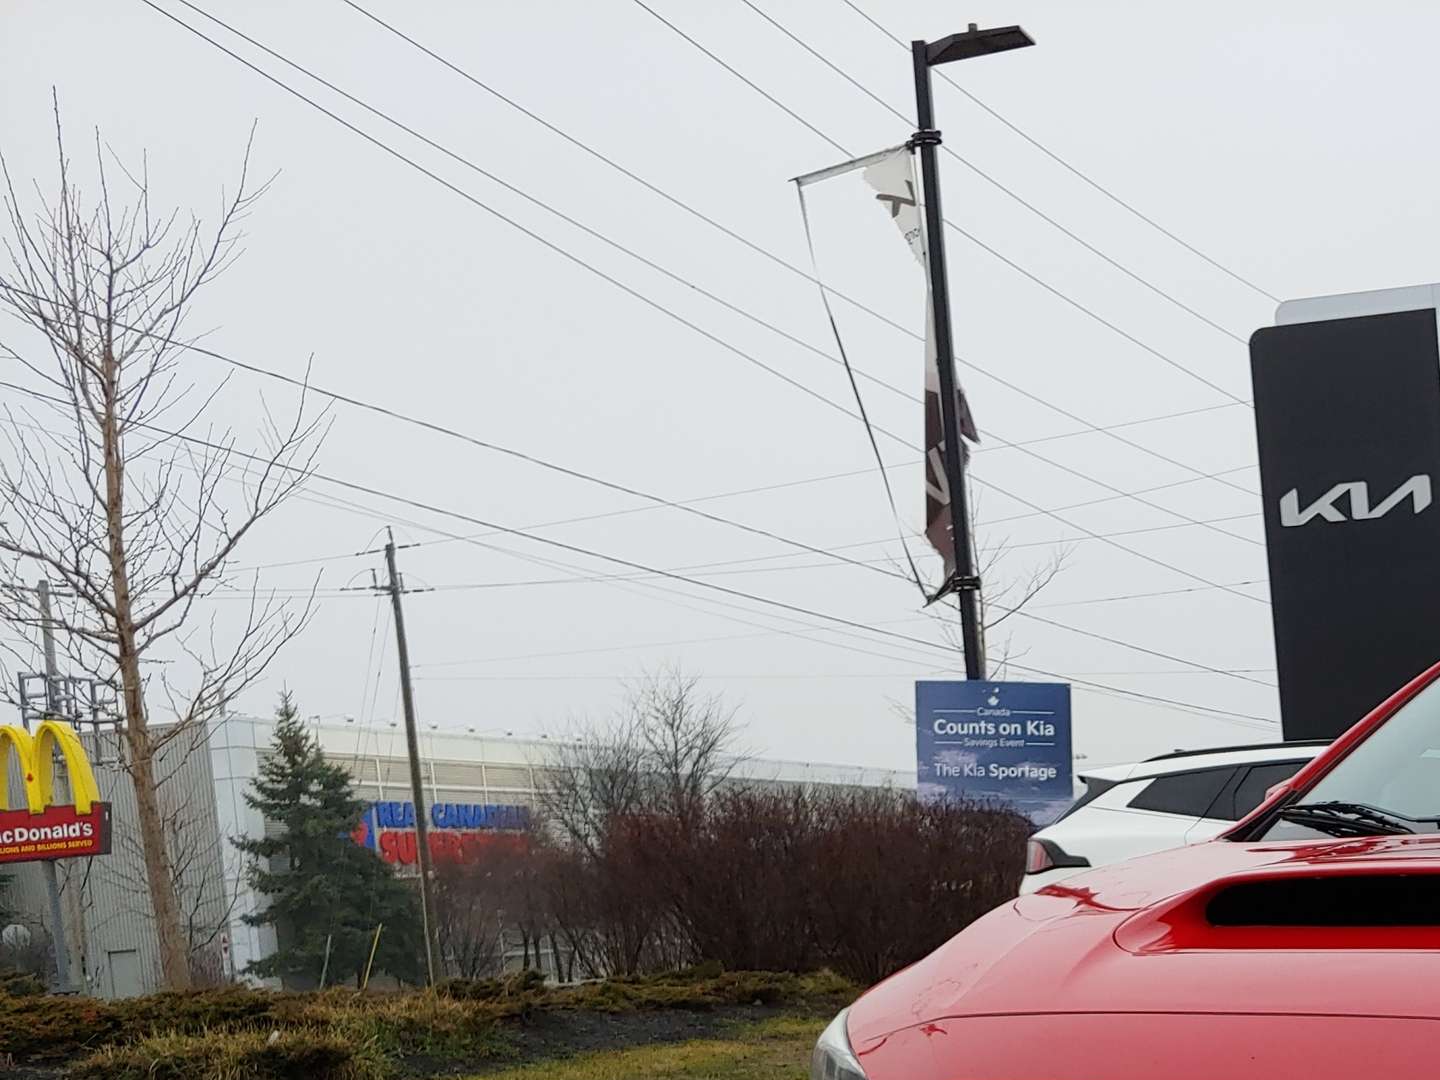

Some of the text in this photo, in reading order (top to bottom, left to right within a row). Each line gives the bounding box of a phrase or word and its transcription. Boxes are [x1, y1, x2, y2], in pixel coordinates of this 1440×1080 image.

[976, 707, 1011, 717] Canada
[933, 719, 1055, 737] Counts on Kia
[963, 738, 1025, 748] Savings Event
[934, 763, 1057, 781] The Kia Sportage
[375, 801, 417, 828] REA
[0, 822, 93, 844] cDonald's
